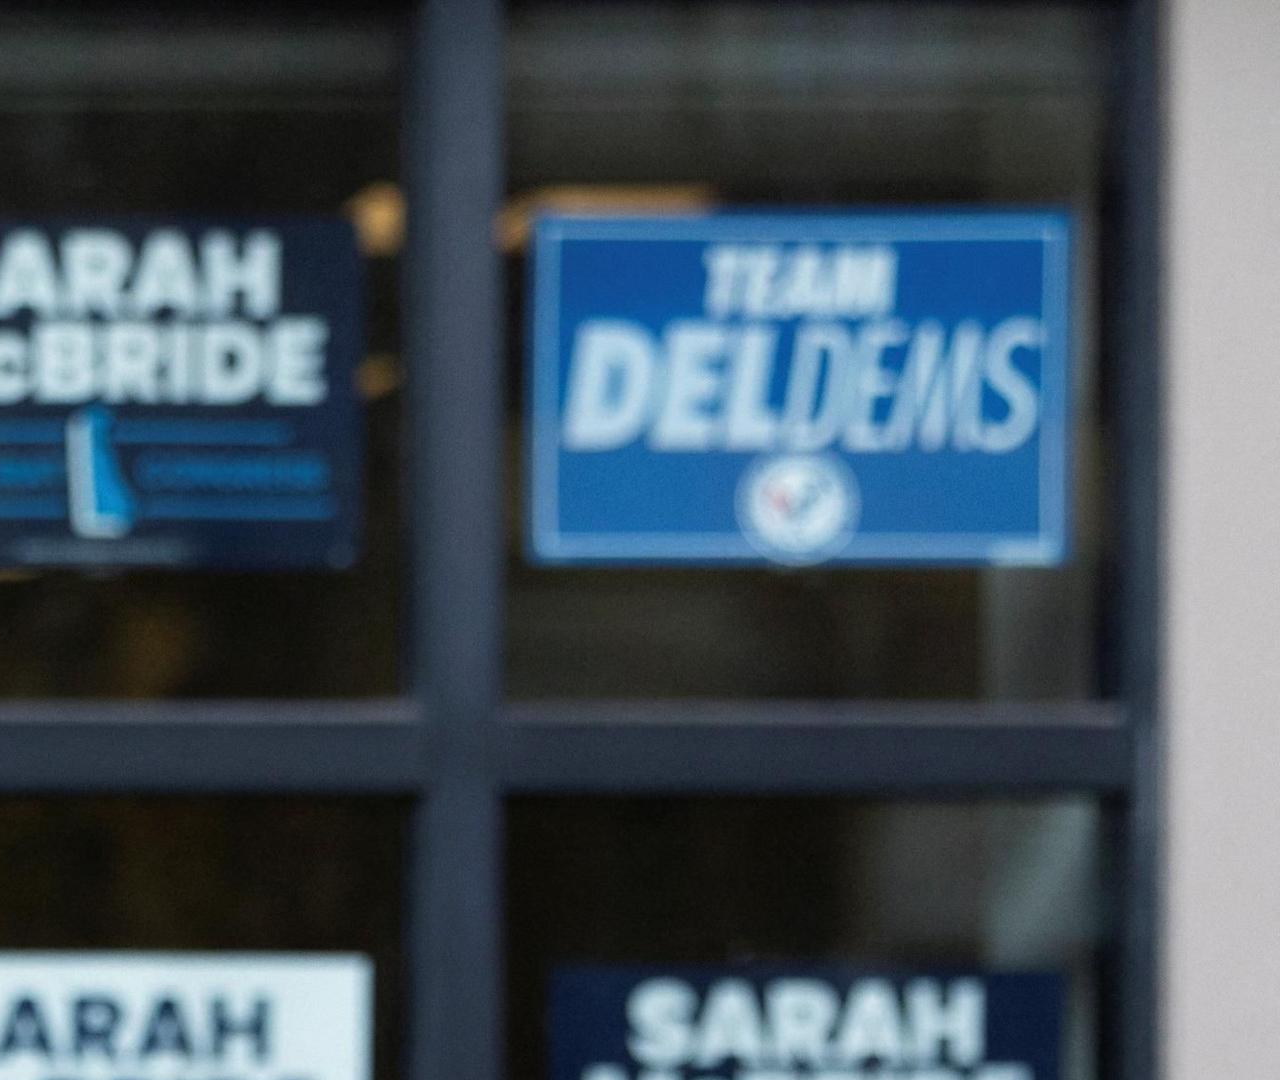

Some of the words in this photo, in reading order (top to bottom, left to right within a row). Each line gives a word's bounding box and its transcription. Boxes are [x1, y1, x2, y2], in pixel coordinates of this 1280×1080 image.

[704, 244, 899, 321] TEAM
[562, 316, 1048, 453] DELDEMS
[626, 976, 987, 1069] SARAH
